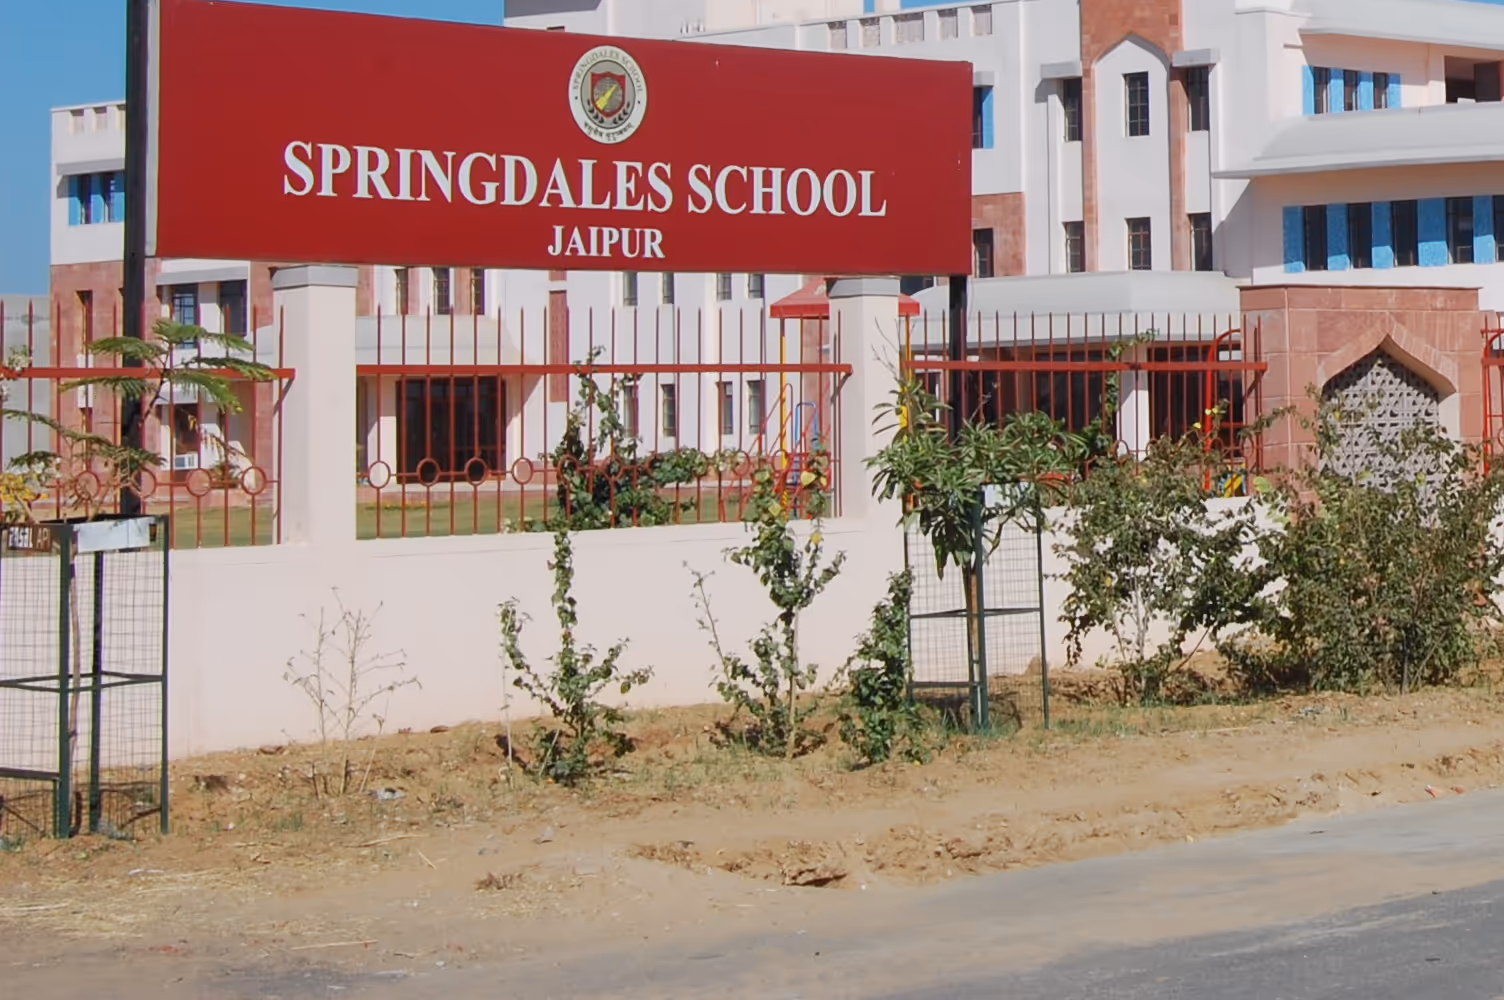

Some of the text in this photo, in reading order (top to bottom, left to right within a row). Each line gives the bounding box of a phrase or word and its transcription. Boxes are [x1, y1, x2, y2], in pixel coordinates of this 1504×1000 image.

[283, 140, 887, 218] SPRINGDALES SCHOOL
[548, 225, 666, 260] JAIPUR
